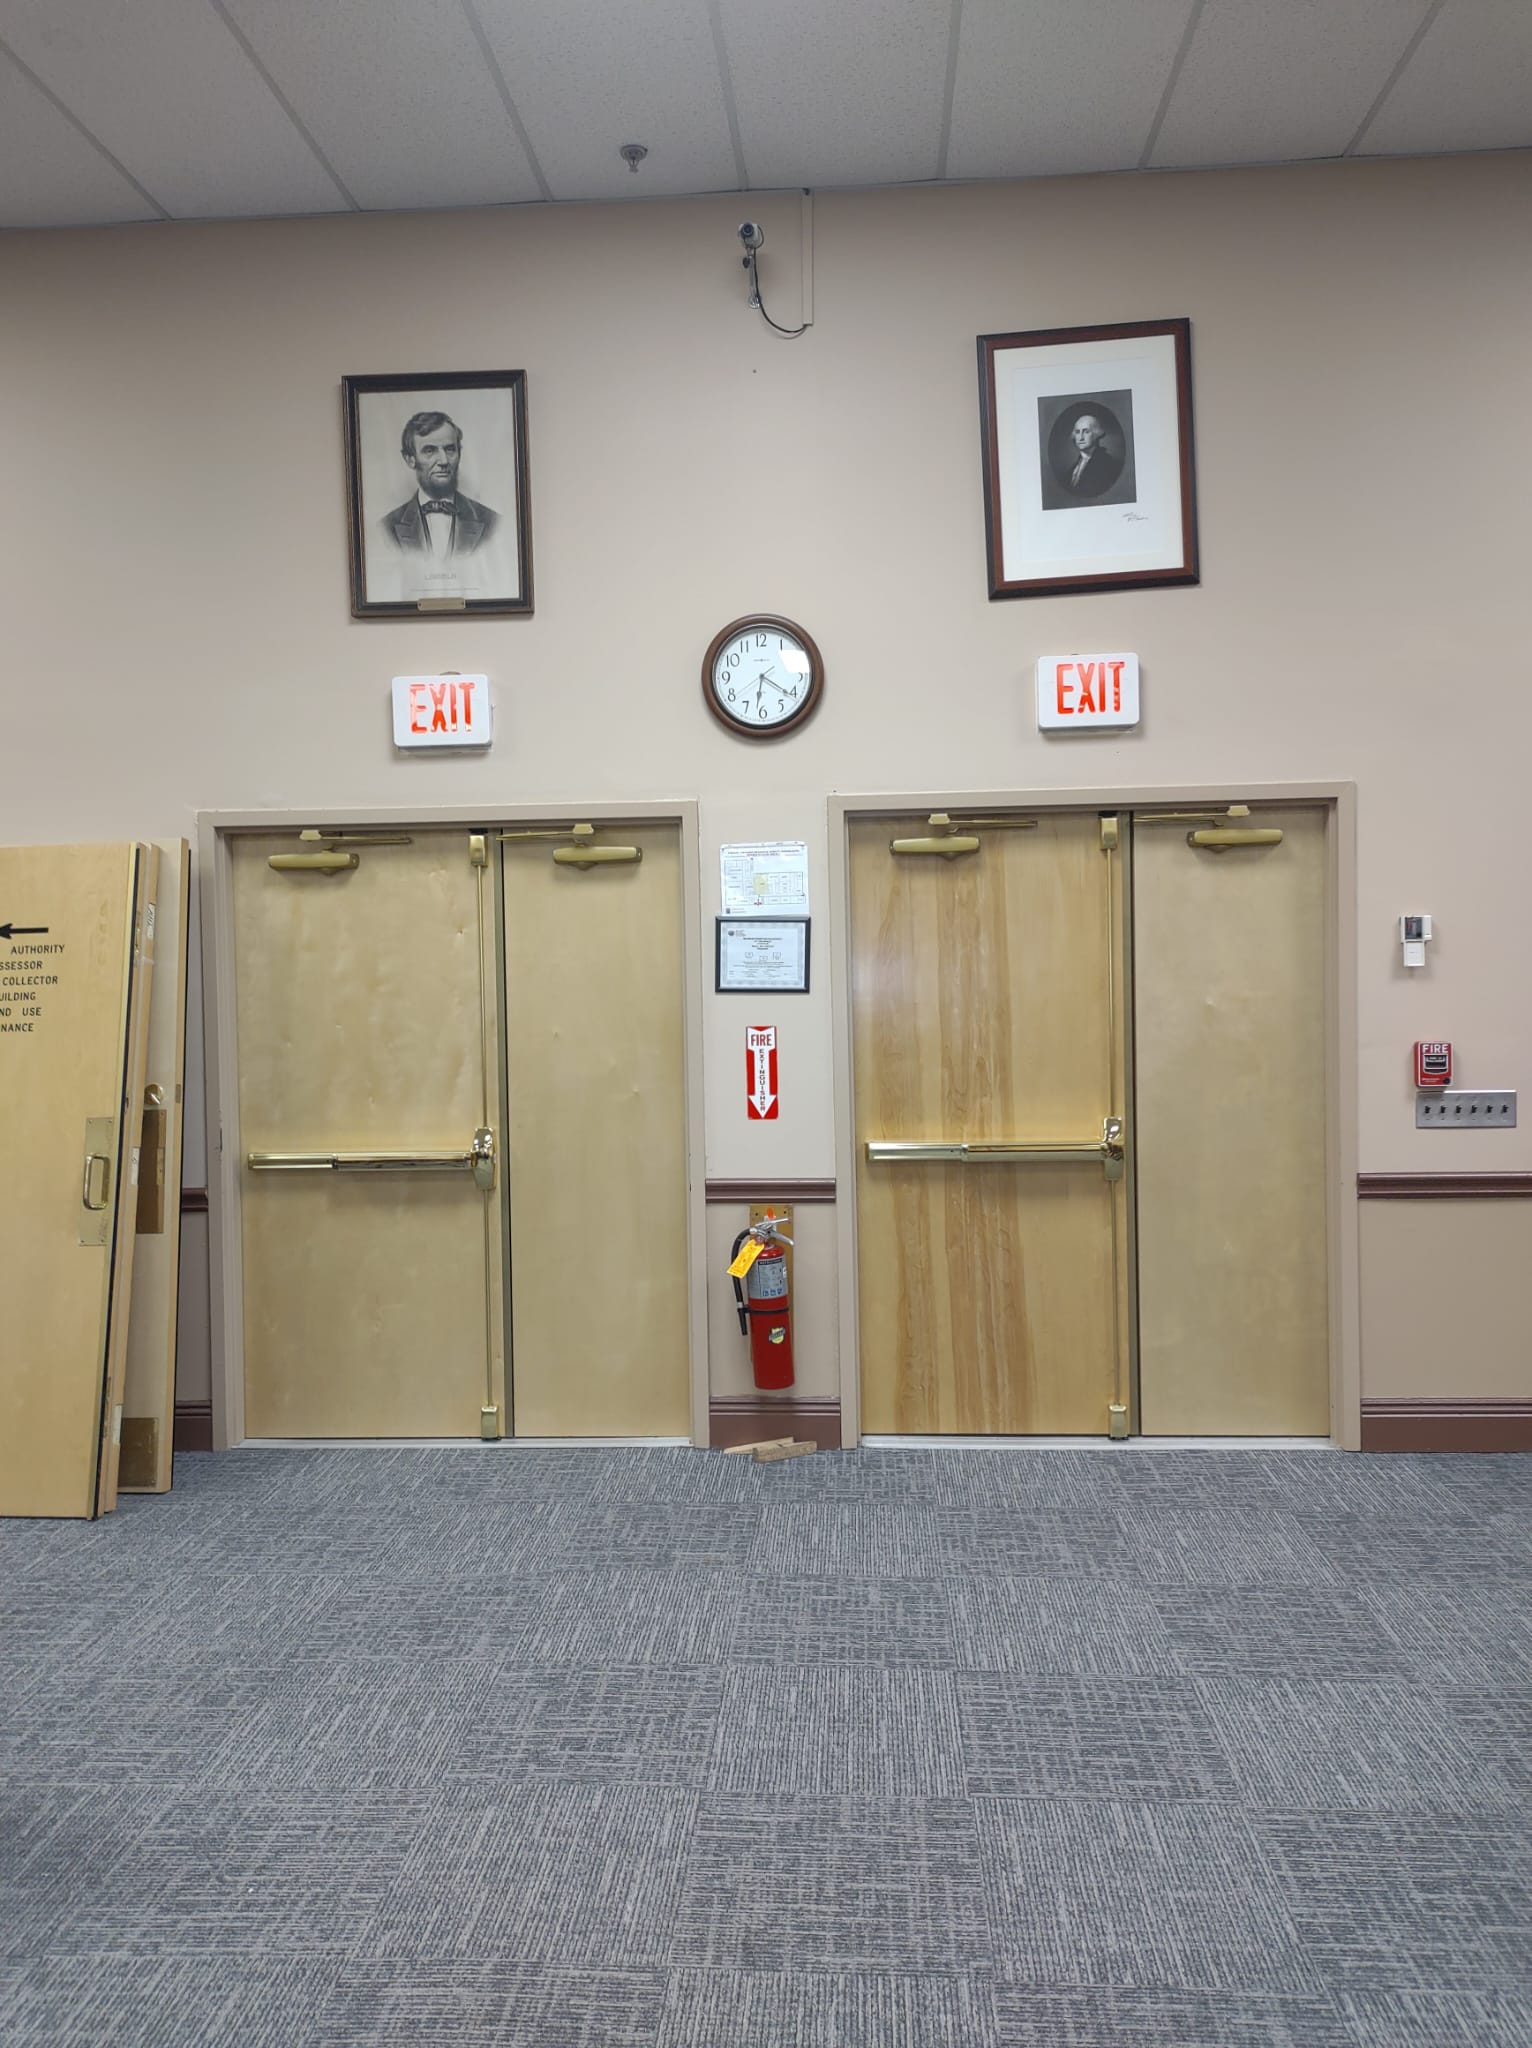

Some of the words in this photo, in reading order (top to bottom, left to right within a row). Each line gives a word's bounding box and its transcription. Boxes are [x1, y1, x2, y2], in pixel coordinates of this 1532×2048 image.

[740, 640, 749, 653] 11
[756, 633, 767, 648] 12
[726, 653, 740, 667] 10
[721, 671, 731, 685] 9
[789, 686, 797, 699] 4
[1056, 661, 1125, 715] EXIT
[727, 689, 736, 702] 8
[409, 682, 475, 734] EXIT
[742, 700, 749, 713] 7
[758, 706, 767, 719] 6
[777, 699, 784, 713] 5
[11, 944, 64, 955] AUTHORITY
[2, 976, 58, 986] COLLECTOR
[22, 1007, 41, 1017] USE
[1, 1023, 33, 1033] NANCE
[750, 1034, 772, 1046] FIRE
[1422, 1043, 1449, 1053] FIRE
